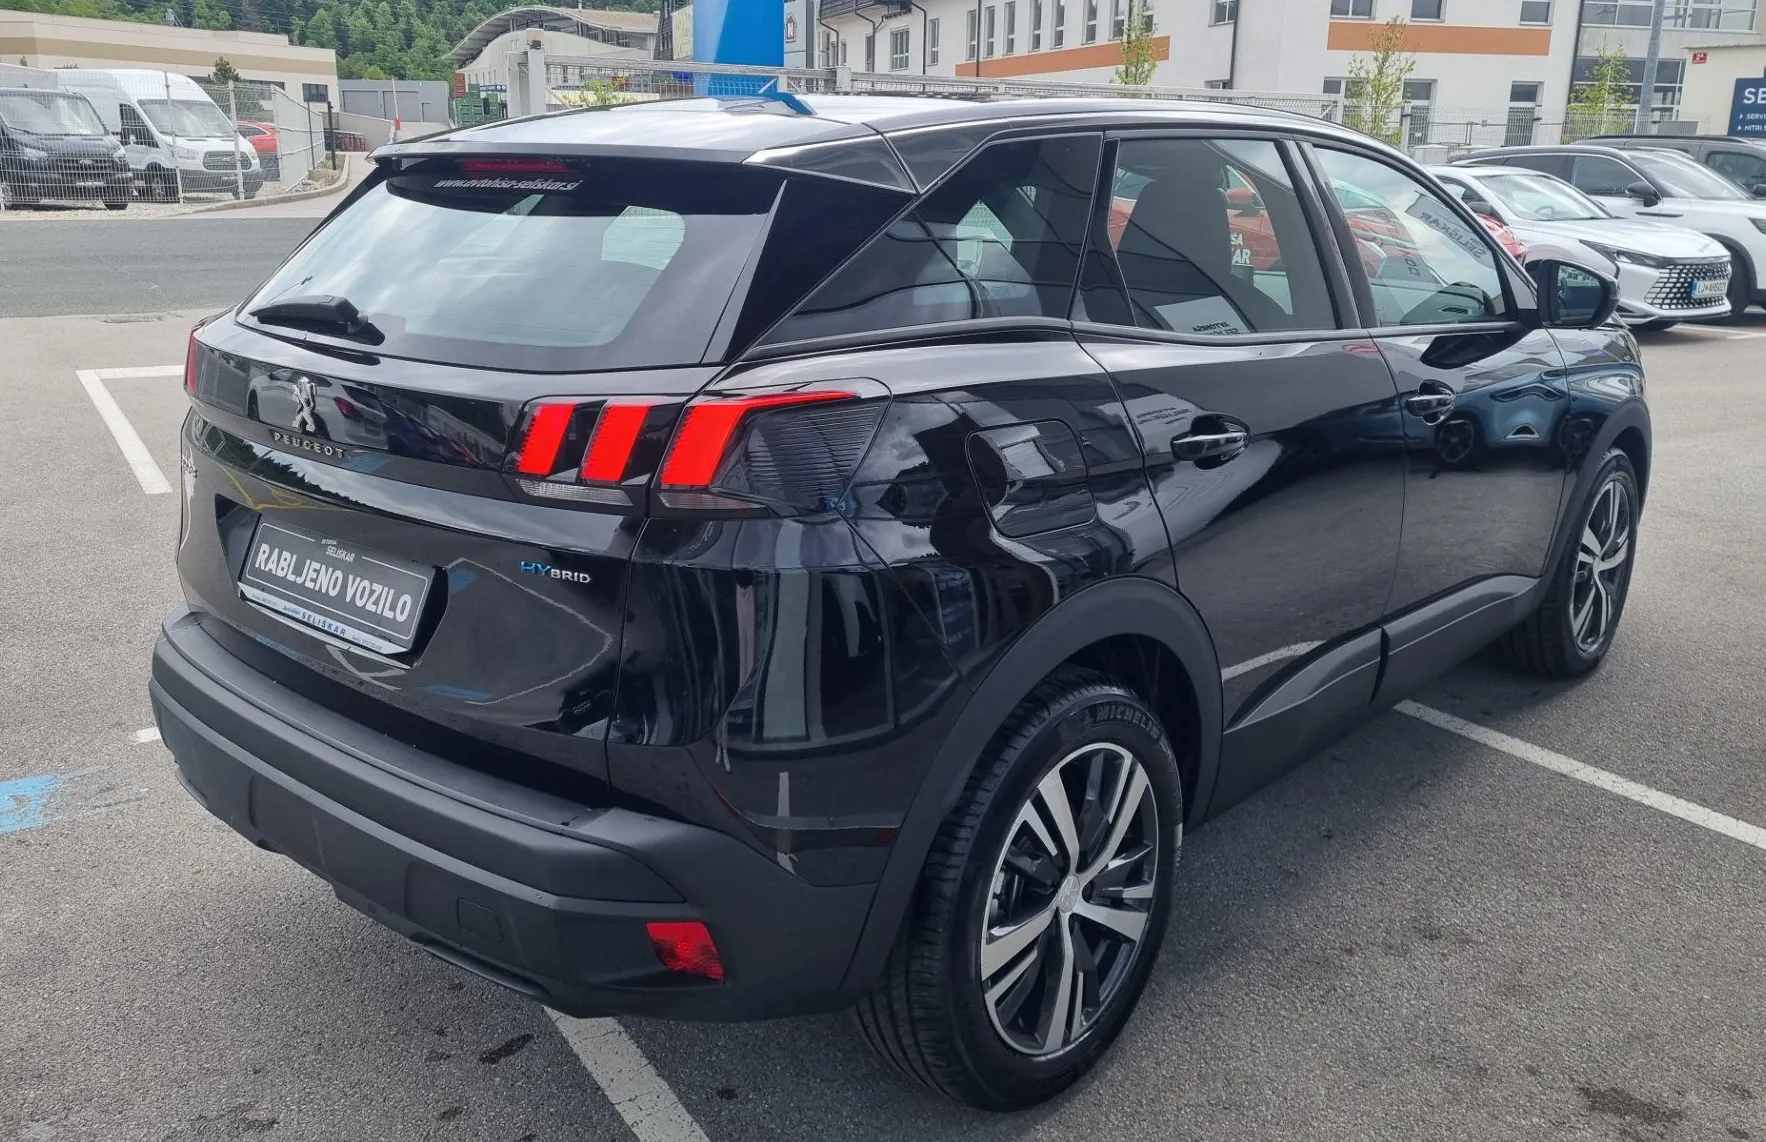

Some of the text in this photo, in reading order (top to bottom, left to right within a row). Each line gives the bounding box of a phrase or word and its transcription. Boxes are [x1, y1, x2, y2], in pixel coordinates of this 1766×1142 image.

[273, 431, 344, 459] PEUGEOT
[255, 543, 412, 622] RABLJENO VOZILO
[519, 560, 592, 583] HYBRID
